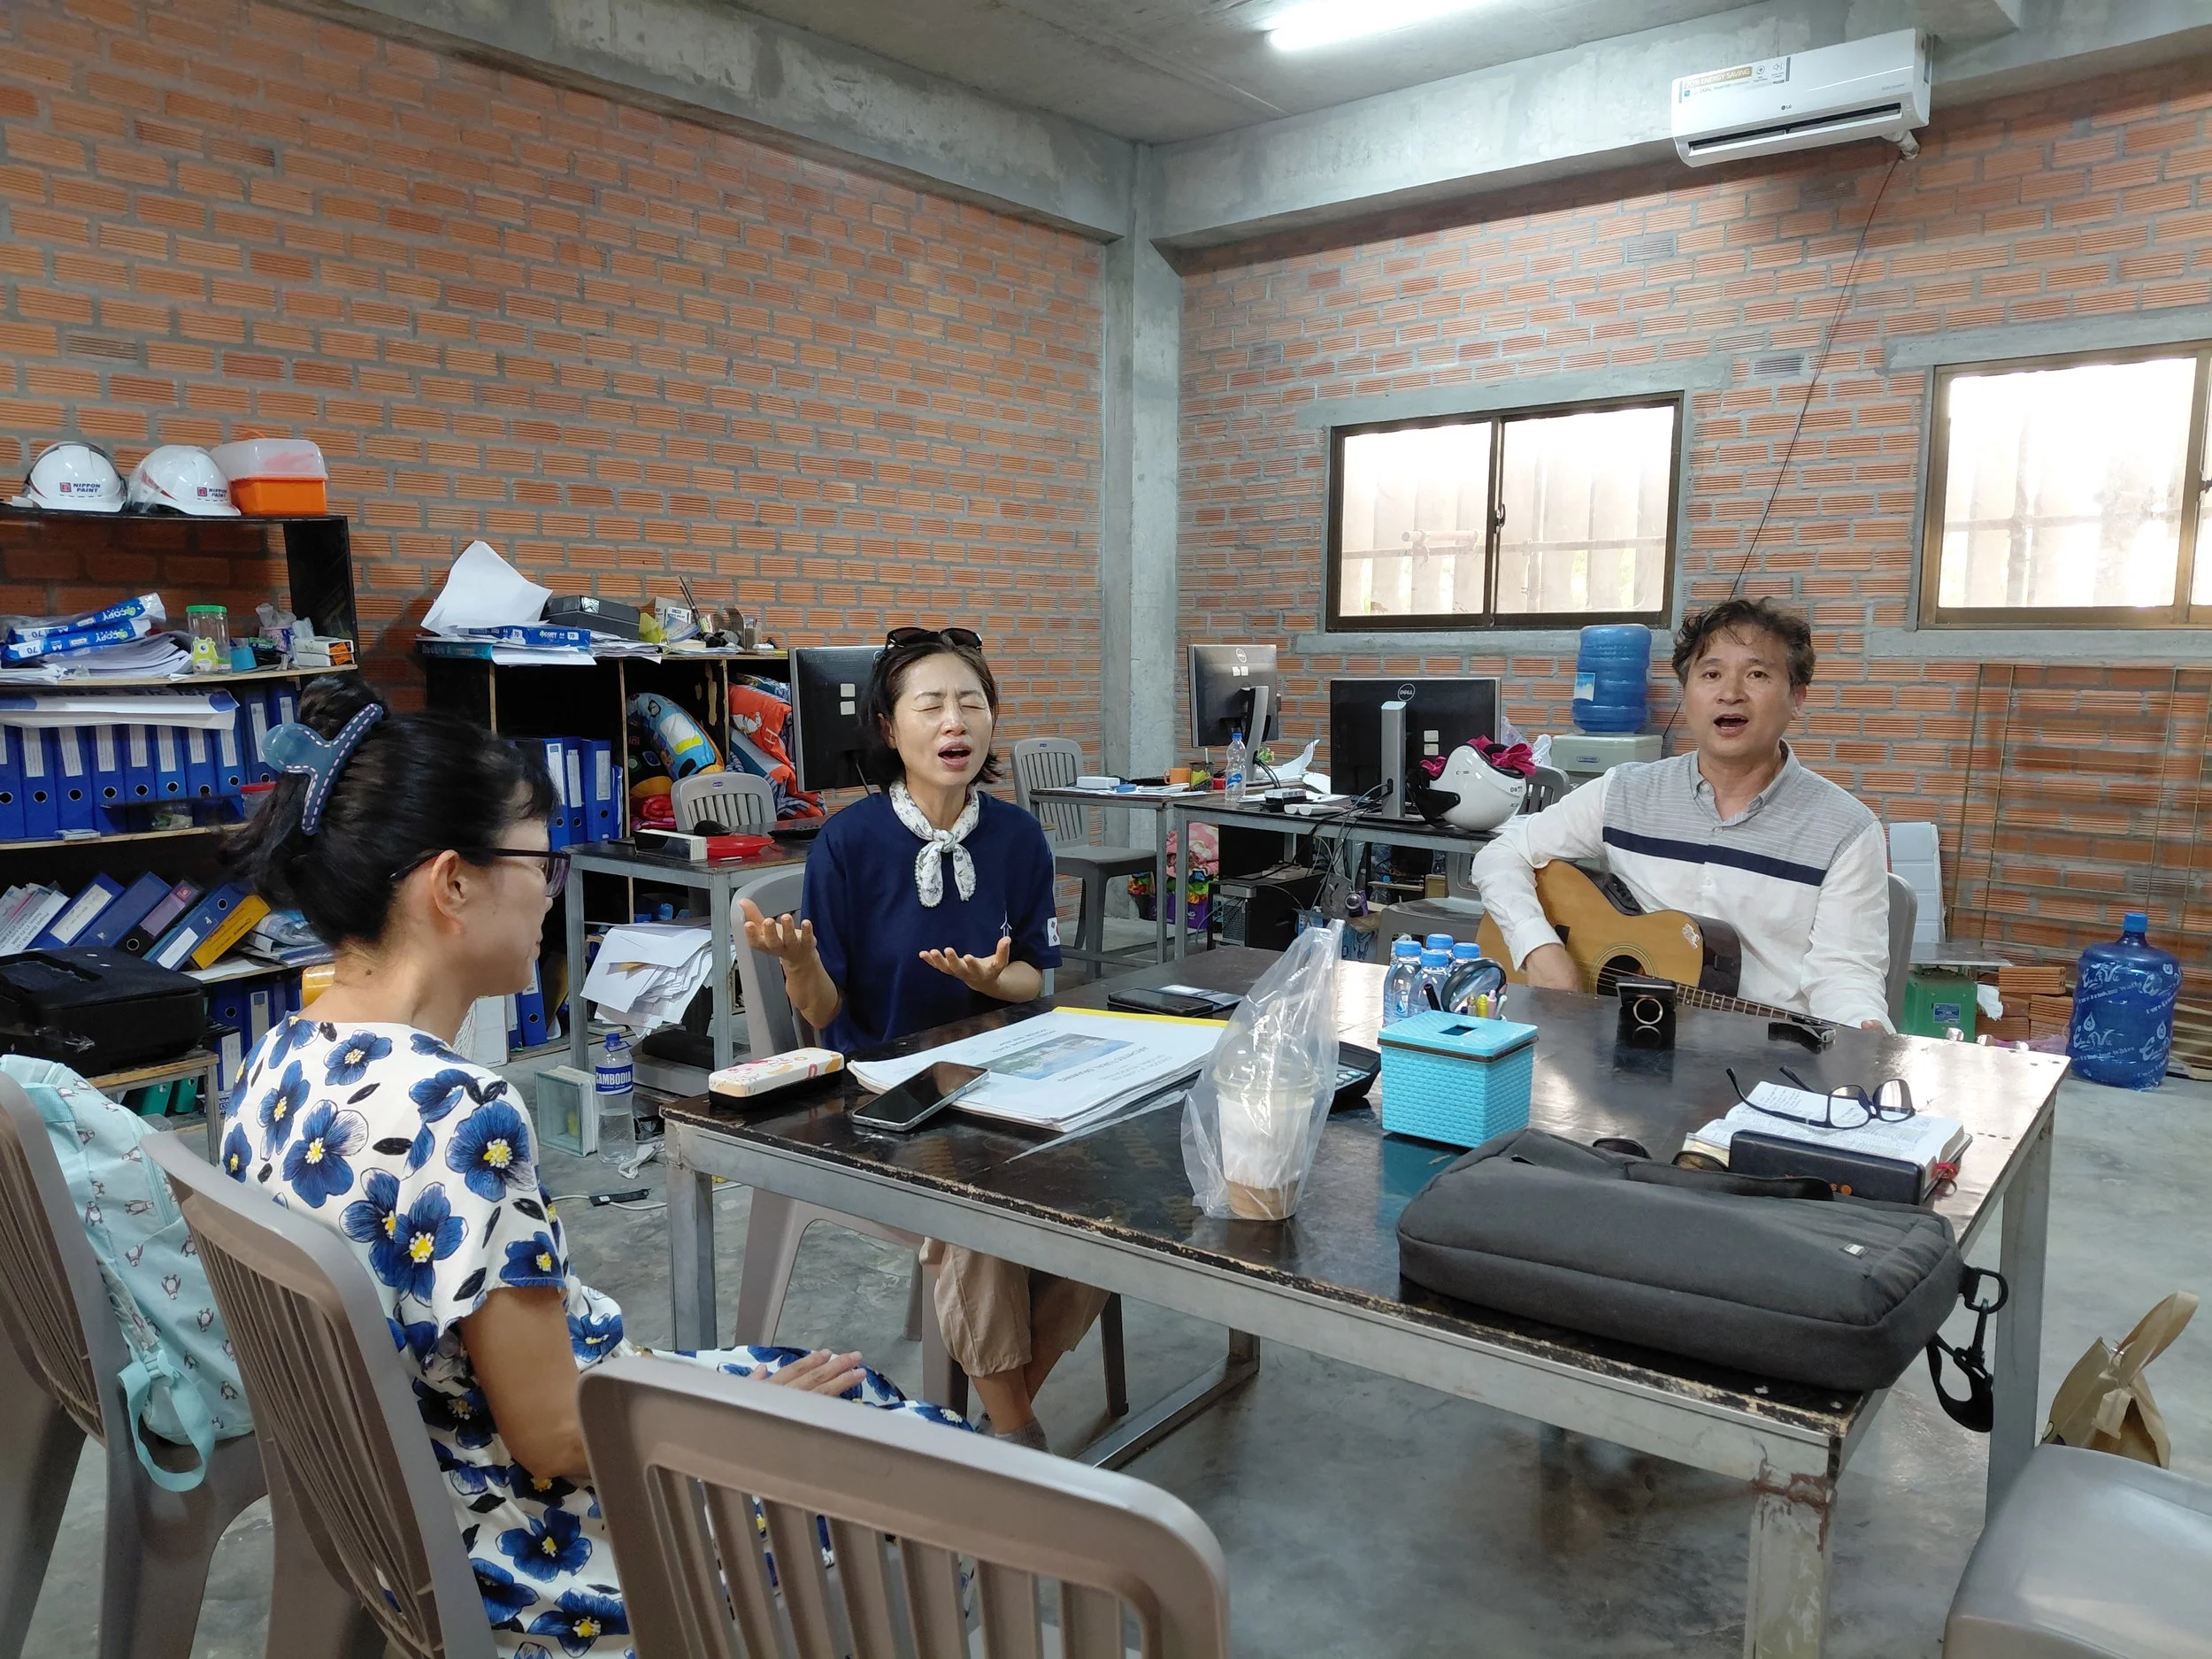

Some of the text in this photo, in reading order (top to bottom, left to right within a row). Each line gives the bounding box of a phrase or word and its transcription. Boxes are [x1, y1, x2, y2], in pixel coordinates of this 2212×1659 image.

[1701, 73, 1724, 85] ENERGY
[1725, 68, 1751, 80] SAVING
[103, 609, 127, 621] COPY
[96, 633, 121, 642] COPY
[595, 1070, 633, 1086] CAMBODIA
